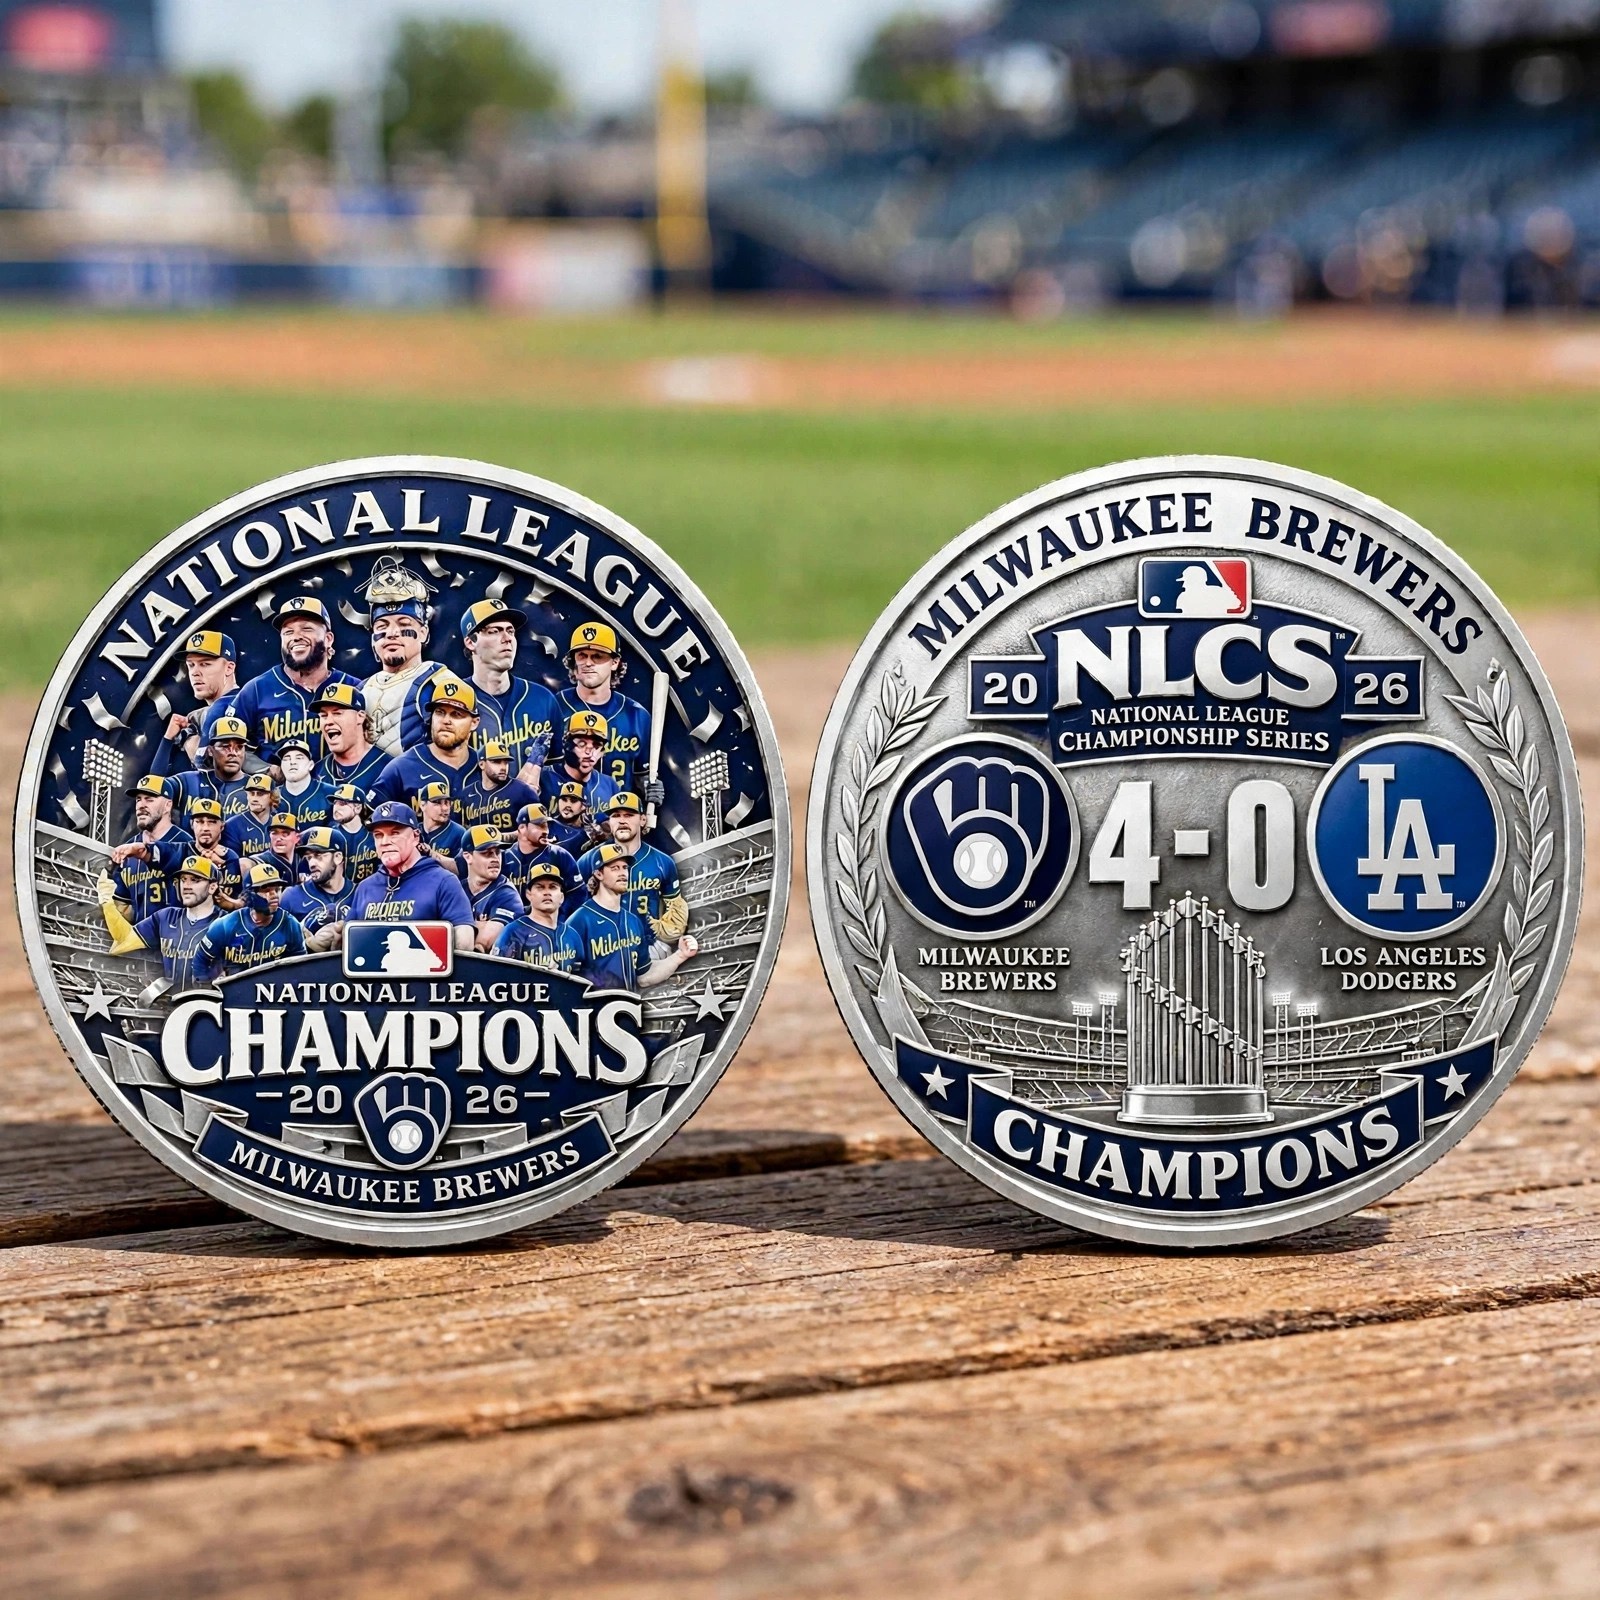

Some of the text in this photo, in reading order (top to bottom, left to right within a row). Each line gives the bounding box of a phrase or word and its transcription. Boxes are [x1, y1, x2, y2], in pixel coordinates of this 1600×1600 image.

[99, 488, 711, 682] NATIONAL LEAGUE
[907, 492, 1484, 661] MILWAUKEE BREWERS
[1052, 622, 1338, 711] NLCS
[983, 672, 1038, 705] 20
[1354, 672, 1409, 705] 26
[1091, 705, 1290, 726] NATIONAL LEAGUE
[1058, 726, 1331, 753] CHAMPIONSHIP SERIES
[1357, 763, 1456, 911] LA
[918, 946, 1071, 967] MILWAUKEE
[1320, 946, 1487, 967] LOS ANGELES
[255, 982, 550, 1004] NATIONAL LEAGUE
[940, 971, 1058, 992] BREWERS
[1341, 971, 1458, 992] DODGERS
[161, 999, 648, 1086] CHAMPIONS
[289, 1084, 518, 1114] 20 26
[993, 1104, 1400, 1200] CHAMPIONS
[228, 1140, 581, 1204] MILWAUKEE BREWERS
